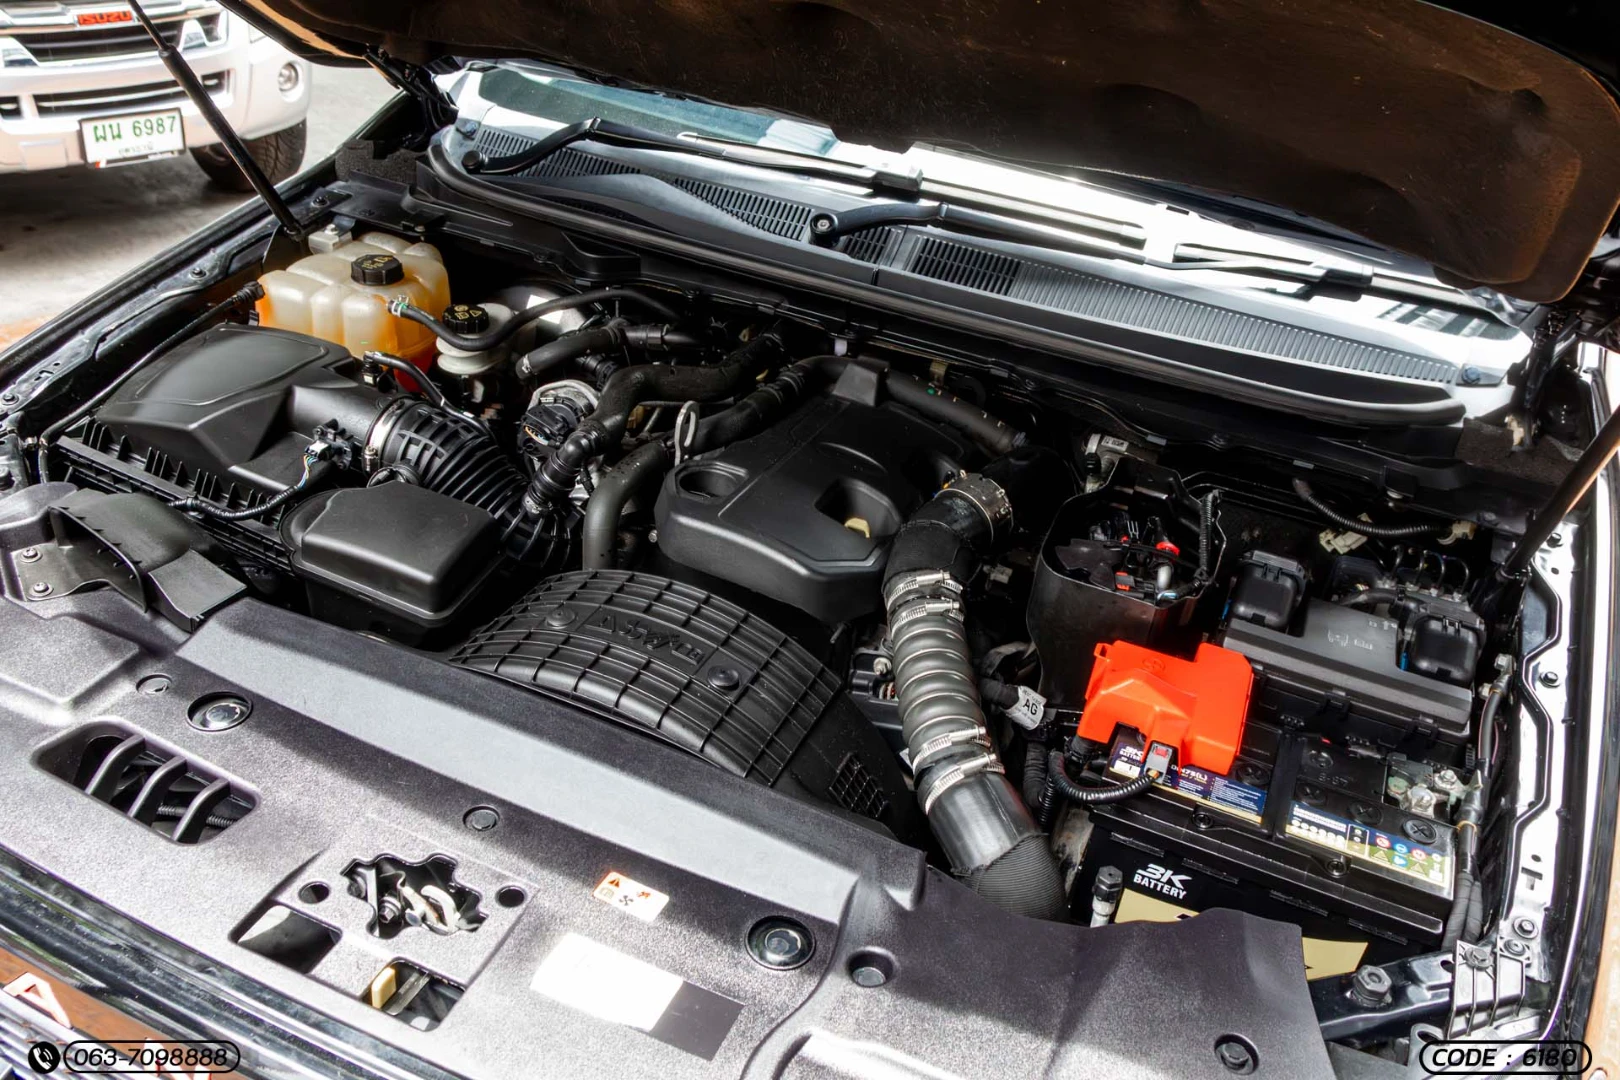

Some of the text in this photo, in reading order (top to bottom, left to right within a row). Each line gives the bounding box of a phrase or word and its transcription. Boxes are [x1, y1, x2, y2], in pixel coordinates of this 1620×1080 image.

[77, 11, 133, 26] ISUZU
[132, 115, 176, 137] 6987
[1023, 699, 1038, 715] AG
[1133, 873, 1187, 899] BATTERY
[1136, 863, 1193, 889] 3K
